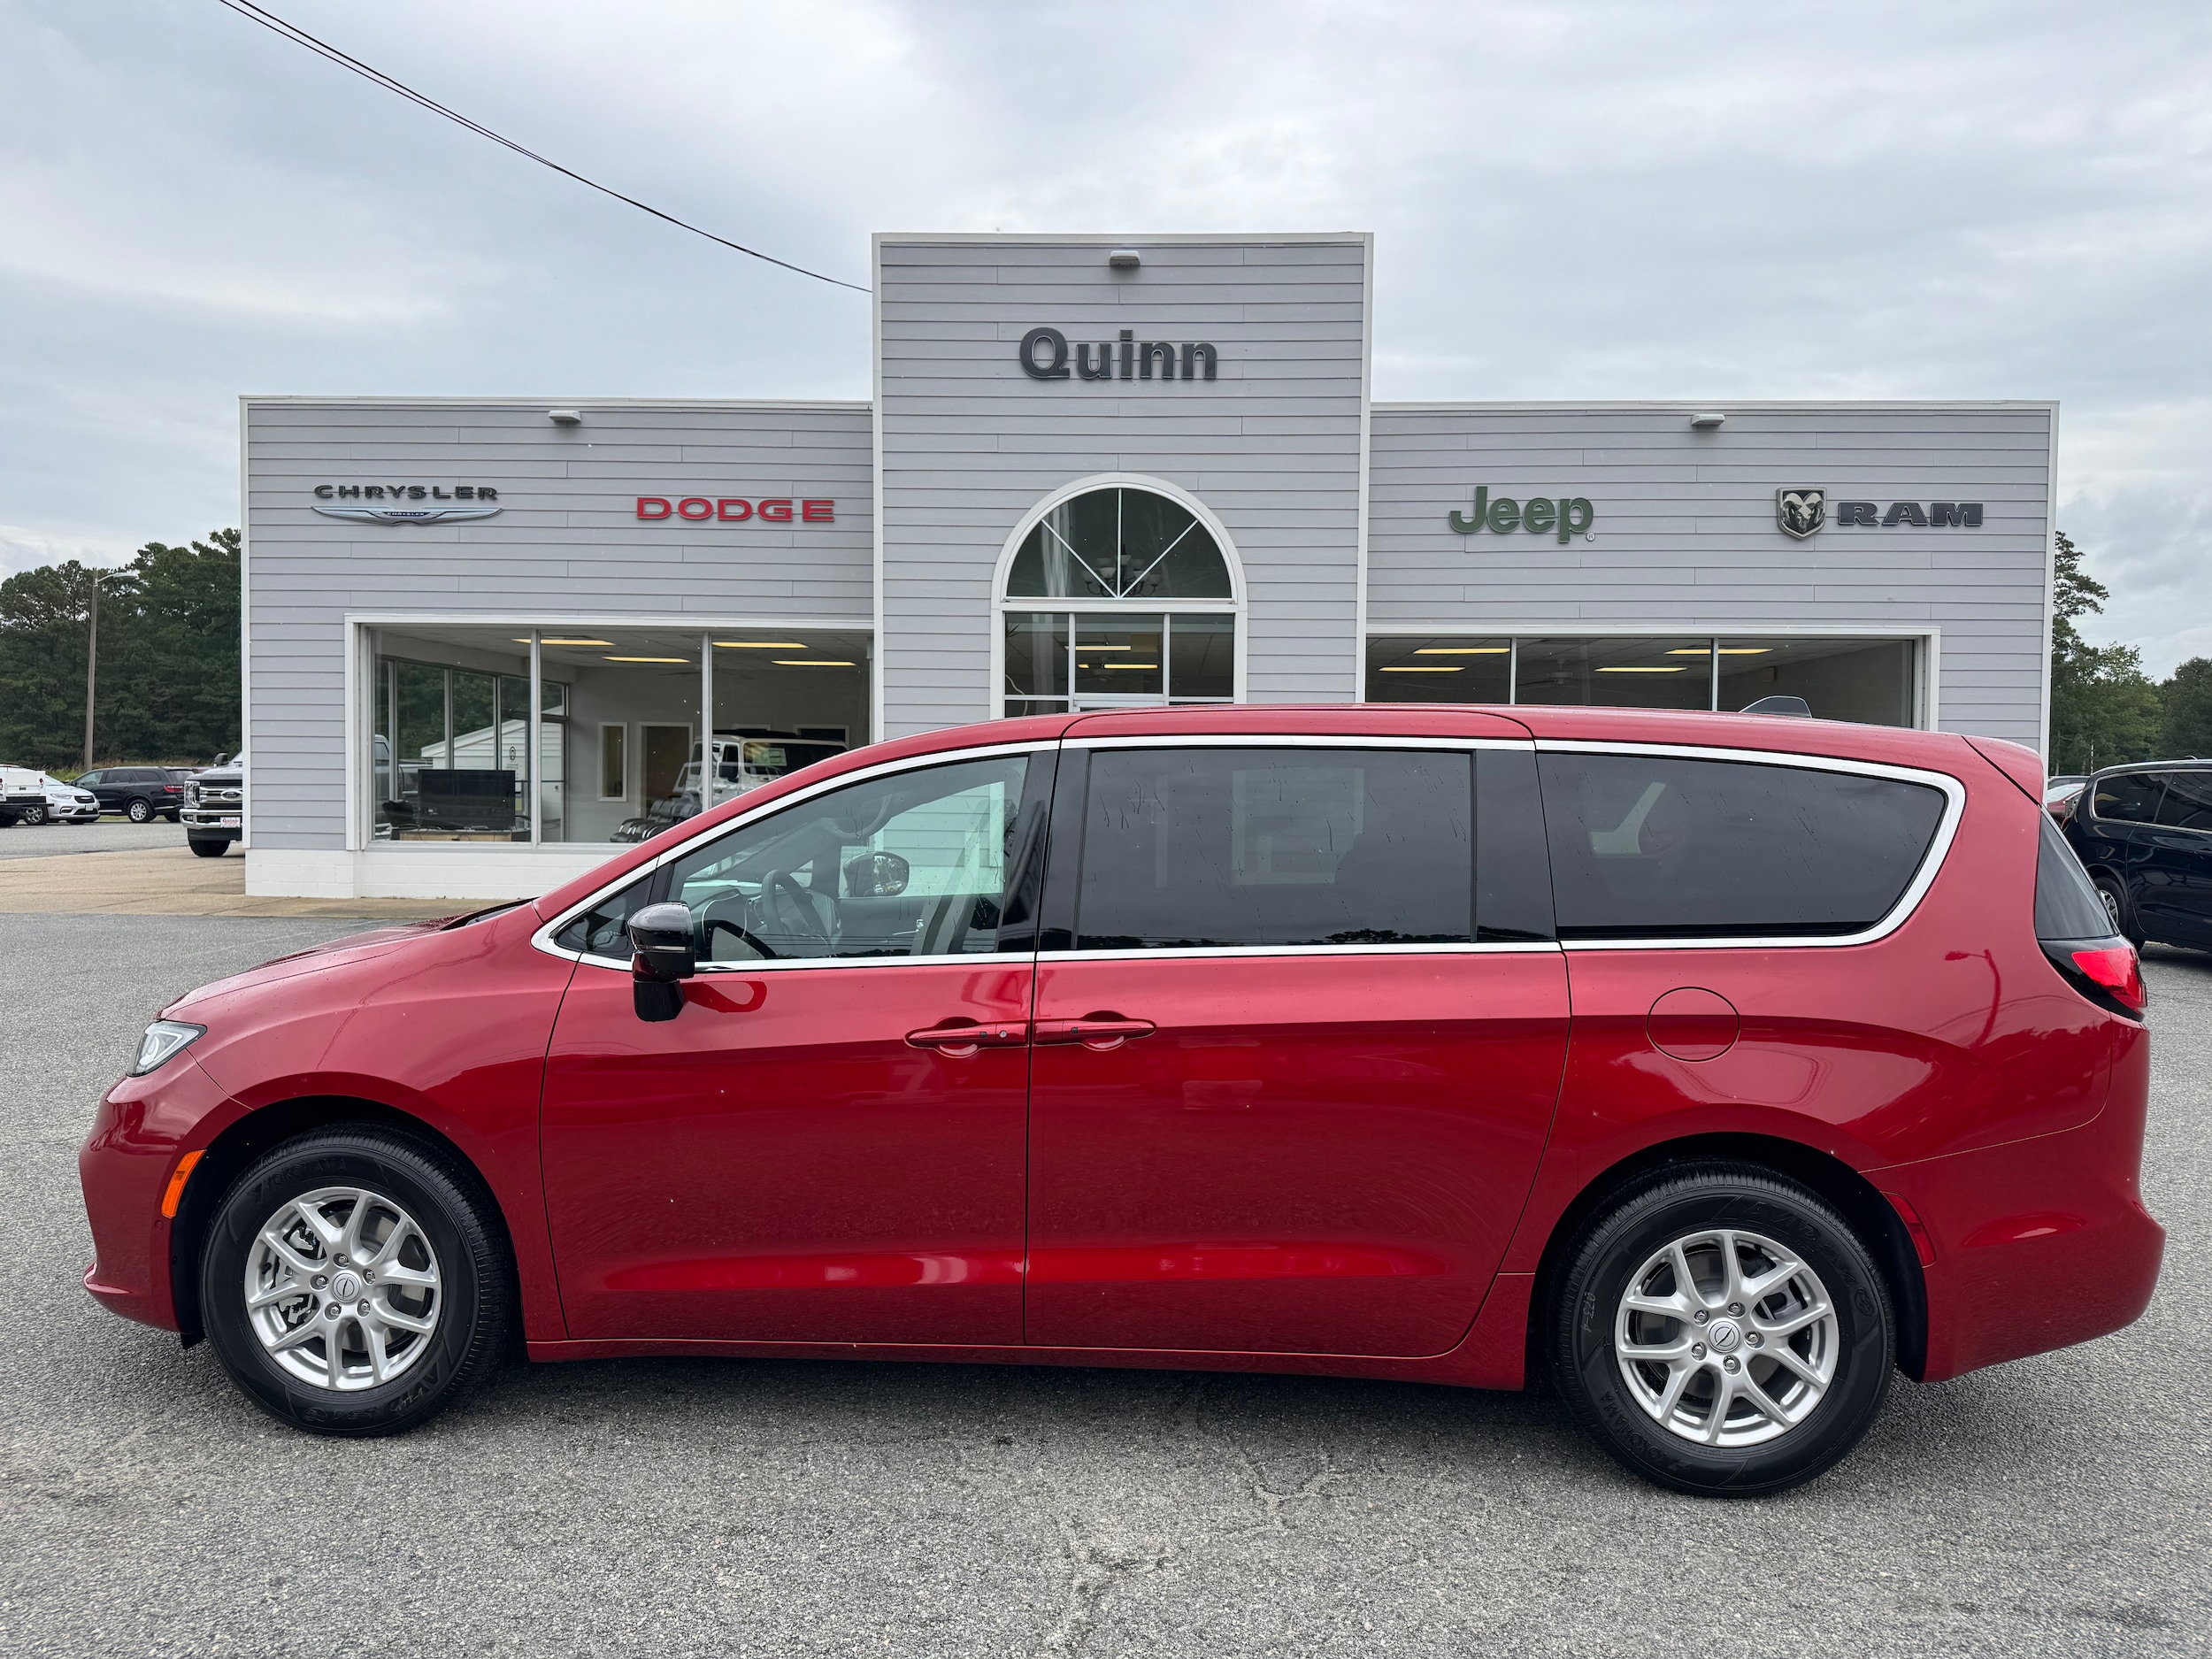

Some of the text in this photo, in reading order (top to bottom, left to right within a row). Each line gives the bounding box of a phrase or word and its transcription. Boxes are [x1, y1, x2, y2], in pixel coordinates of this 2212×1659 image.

[1019, 326, 1217, 380] Quinn
[313, 485, 498, 501] CHRYSLER
[636, 496, 835, 522] DODGE
[1448, 486, 1594, 544] Jeep
[1838, 502, 1984, 526] RAM
